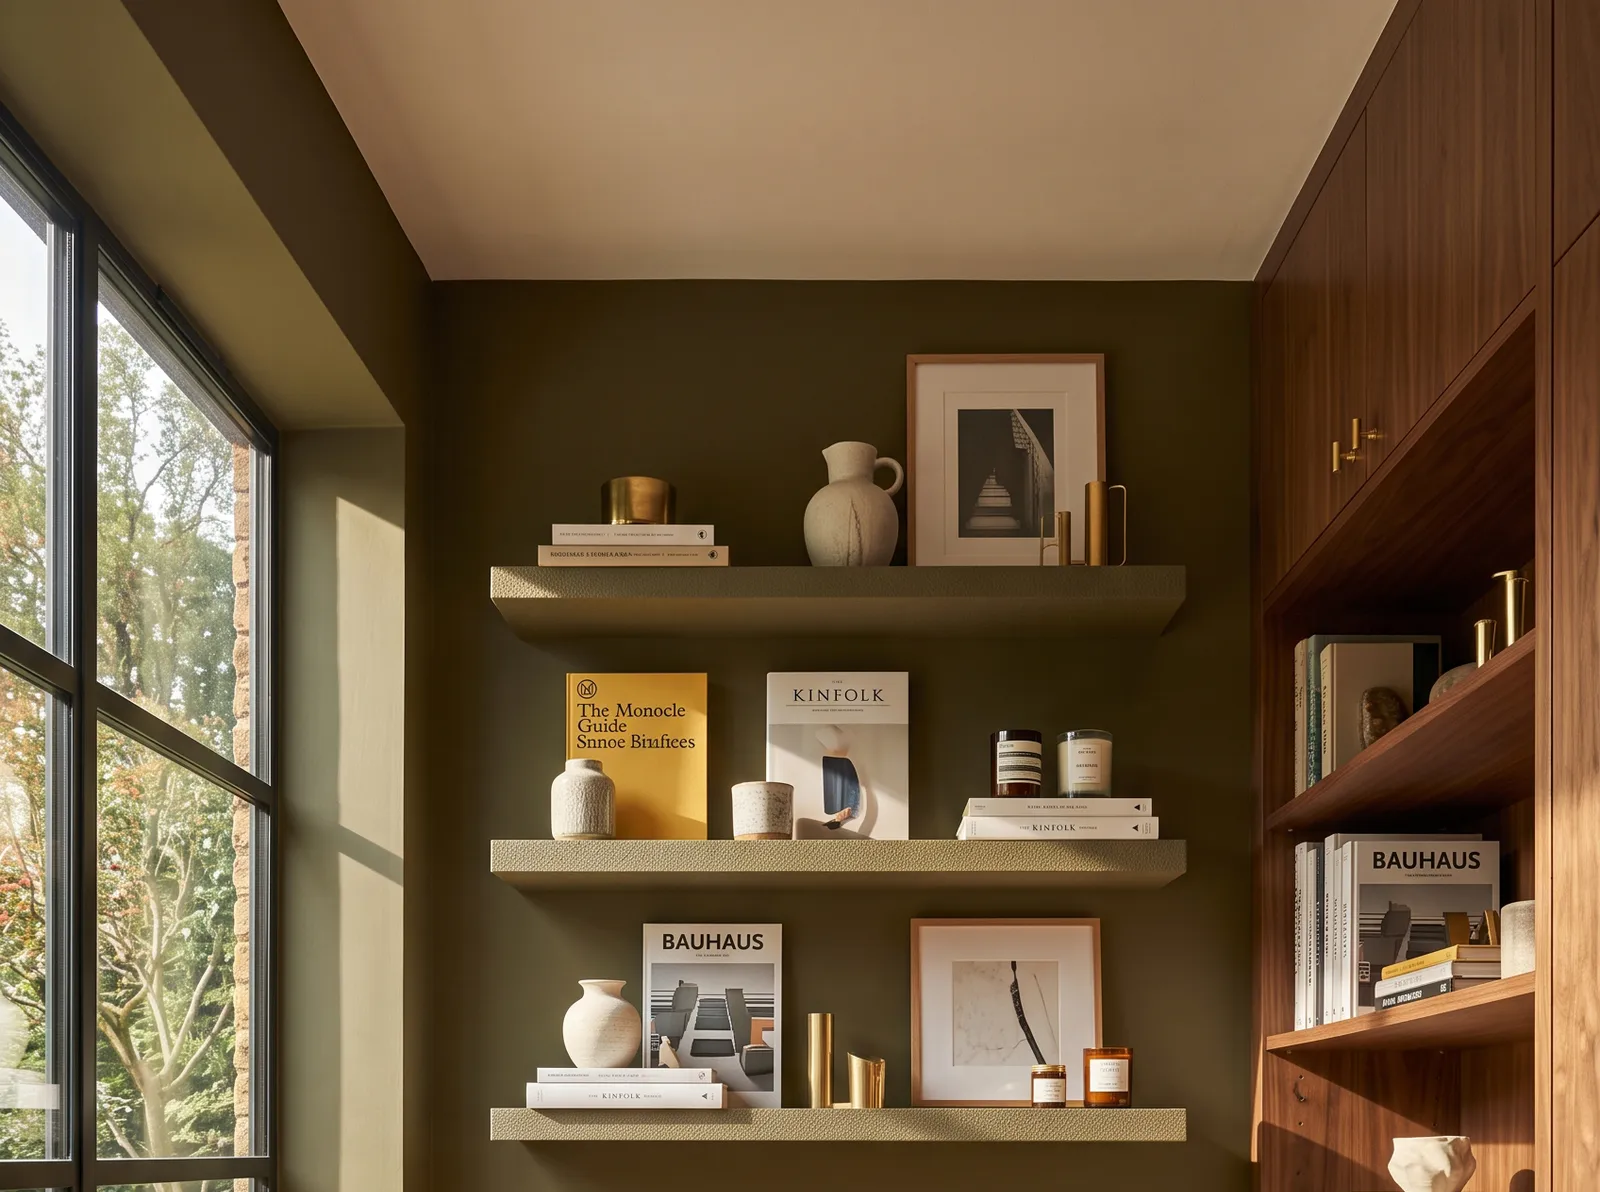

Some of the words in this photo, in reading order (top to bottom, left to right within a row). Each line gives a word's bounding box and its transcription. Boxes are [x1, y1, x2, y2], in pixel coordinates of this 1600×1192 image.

[793, 688, 884, 702] KINFOLK
[577, 703, 609, 718] The
[615, 703, 686, 718] Monocle
[577, 719, 627, 733] Guide
[577, 734, 626, 749] Snnoe
[1032, 823, 1076, 832] KINFOLK
[1373, 851, 1480, 870] BAUHAUS
[662, 933, 764, 950] BAUHAUS
